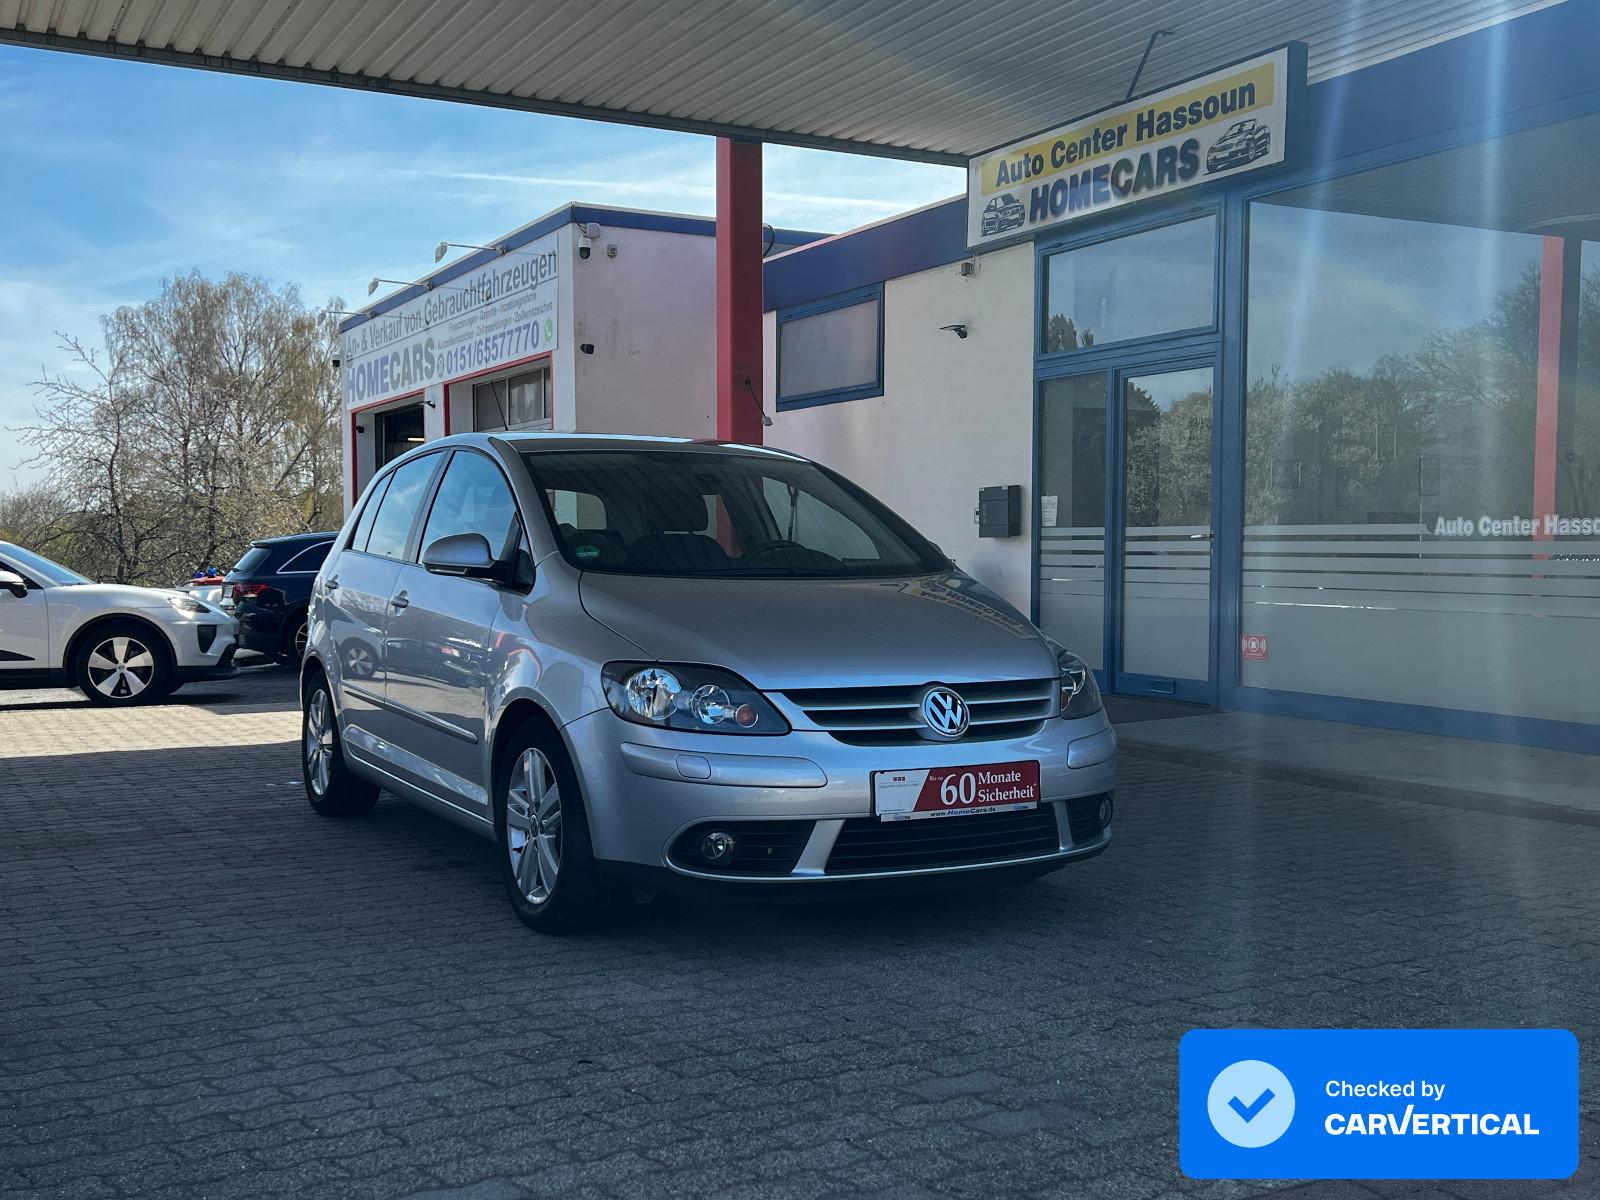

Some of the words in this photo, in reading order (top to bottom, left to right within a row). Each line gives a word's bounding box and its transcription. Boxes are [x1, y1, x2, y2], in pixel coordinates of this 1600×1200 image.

[996, 152, 1044, 187] Auto
[1051, 123, 1128, 169] Center
[1136, 82, 1256, 141] Hassoun
[1029, 138, 1199, 223] HOMECARS
[361, 327, 368, 353] &
[370, 312, 403, 348] Verkauf
[405, 311, 422, 334] von
[424, 249, 557, 326] Gebrauchtfahrzeugen
[347, 337, 435, 403] HOMECARS
[446, 320, 540, 375] 0151/65577770
[1434, 515, 1475, 536] Auto
[1478, 514, 1541, 536] Center
[940, 773, 977, 806] 60
[978, 770, 1021, 785] Monate
